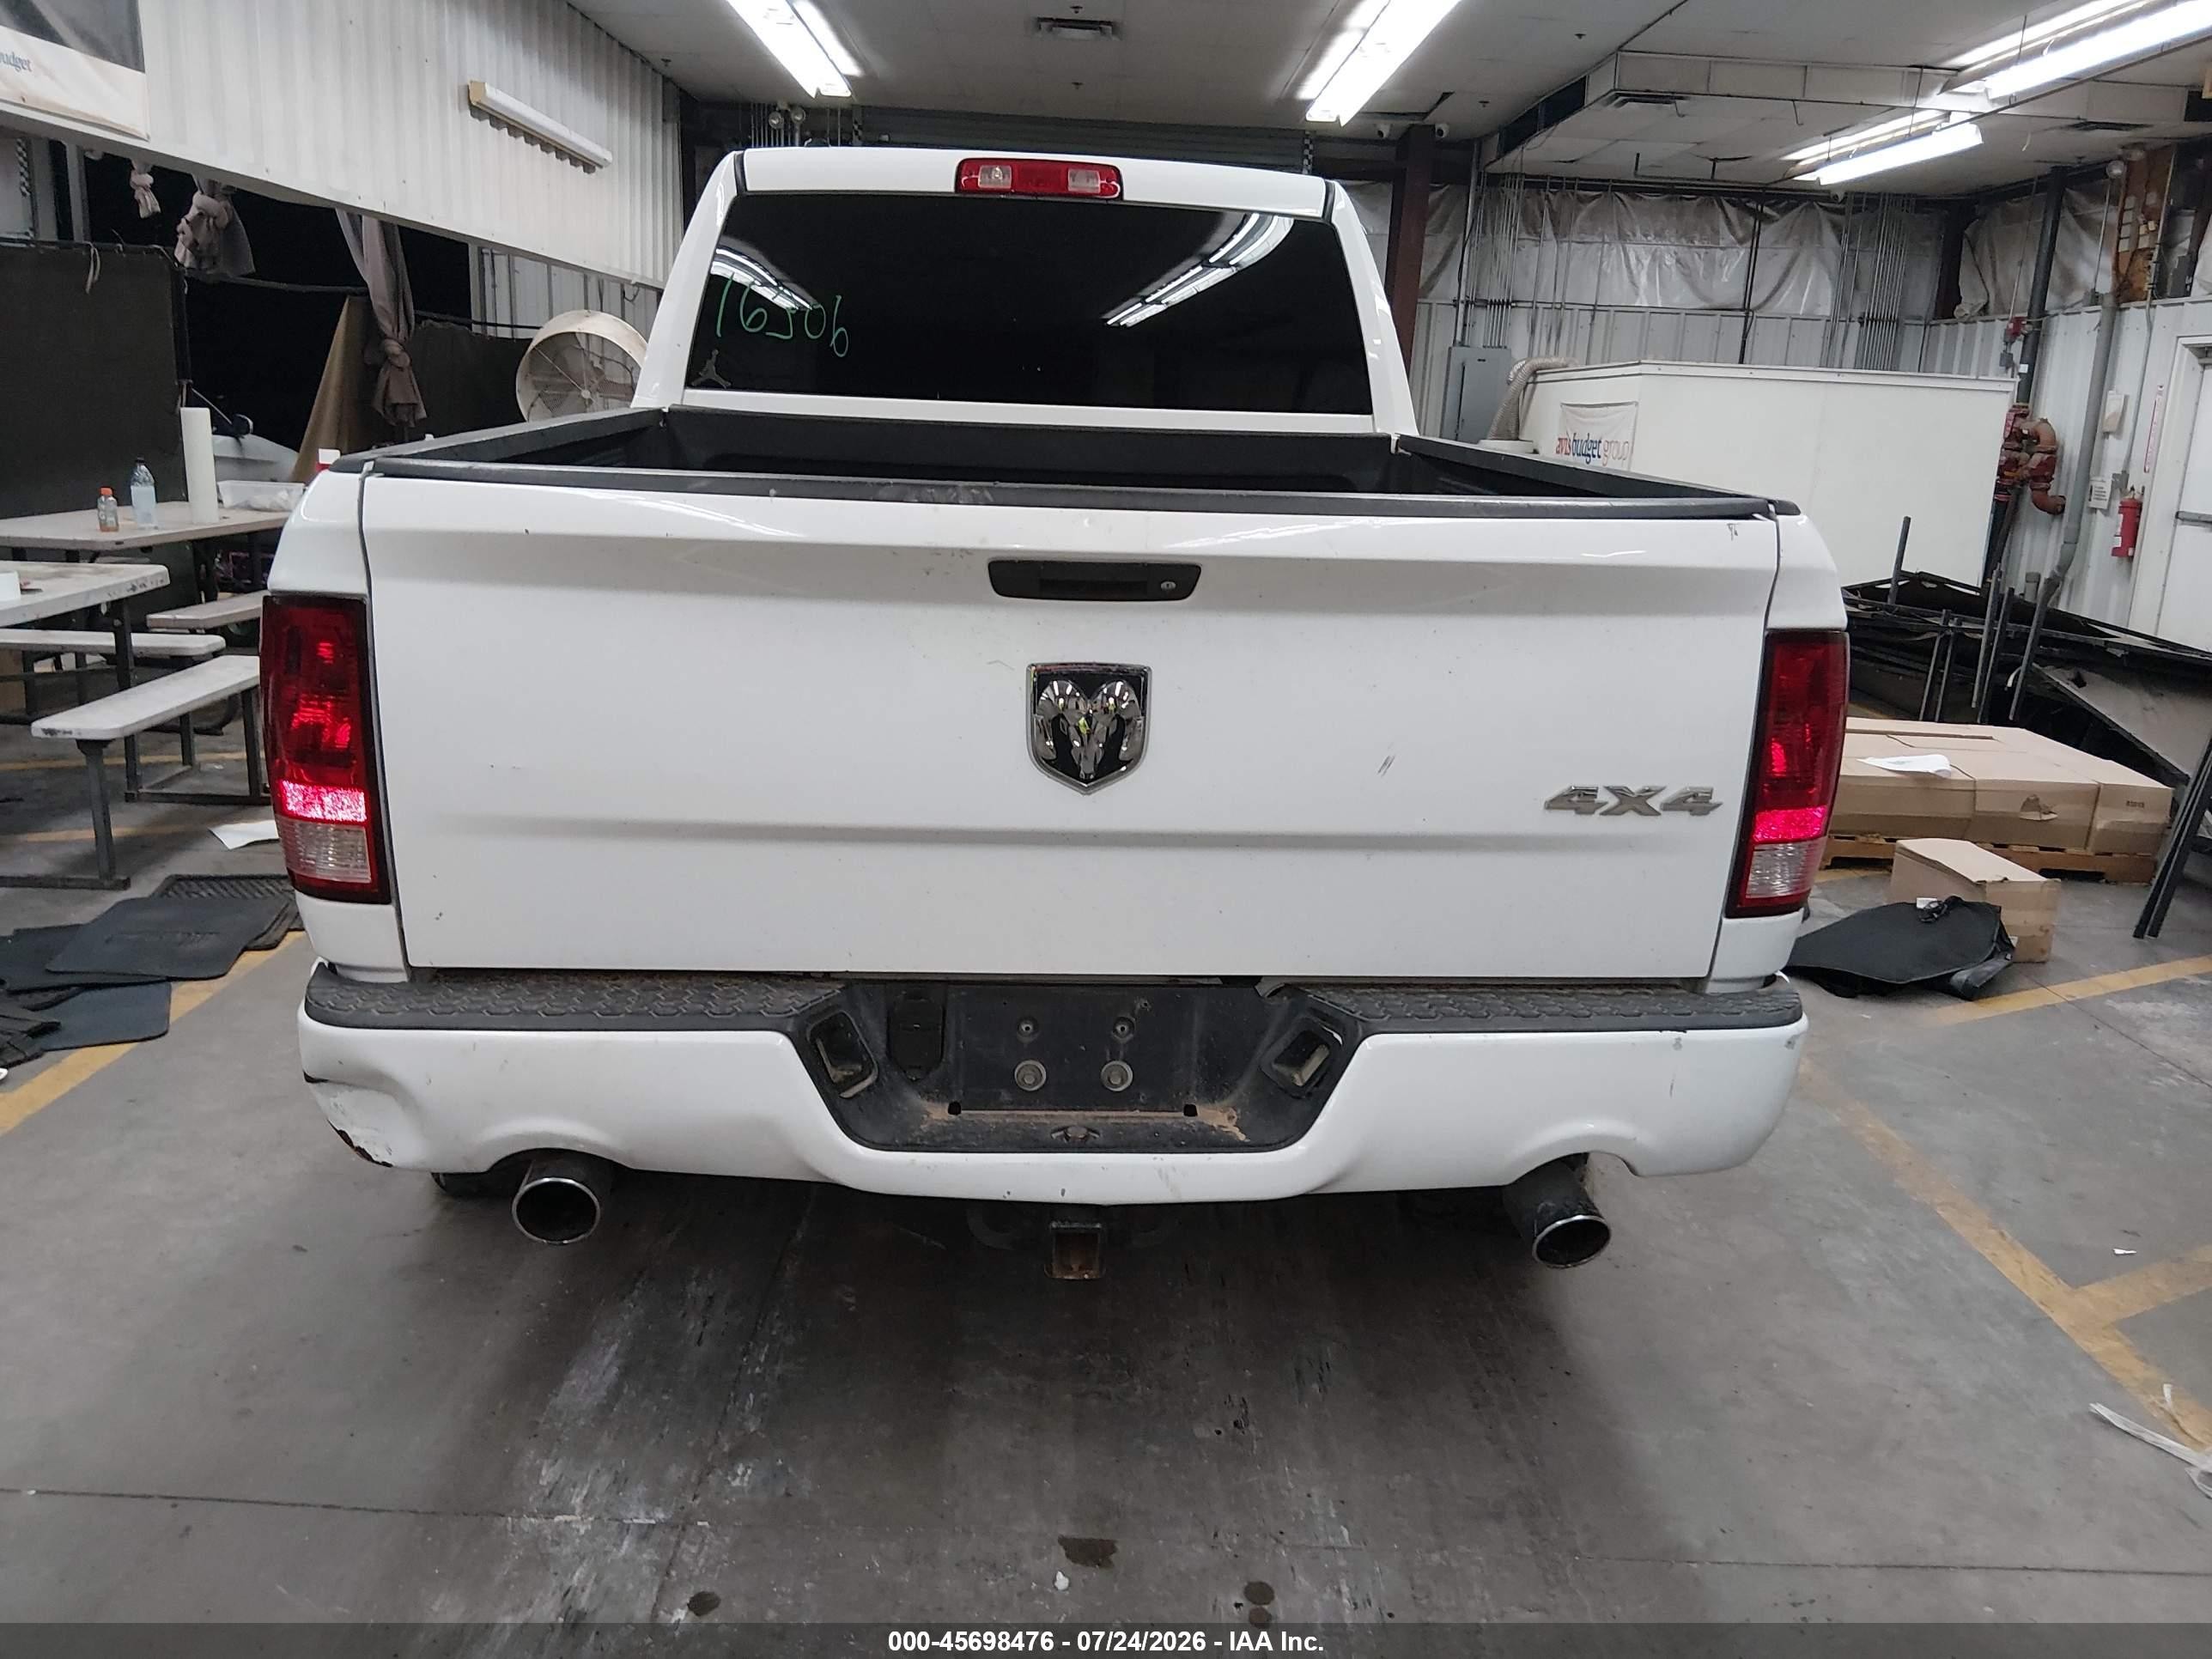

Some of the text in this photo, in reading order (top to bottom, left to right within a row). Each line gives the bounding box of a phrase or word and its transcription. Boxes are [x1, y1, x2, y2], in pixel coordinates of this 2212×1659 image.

[1571, 432, 1601, 465] budget
[1601, 439, 1630, 468] group
[1544, 785, 1723, 817] 4X4
